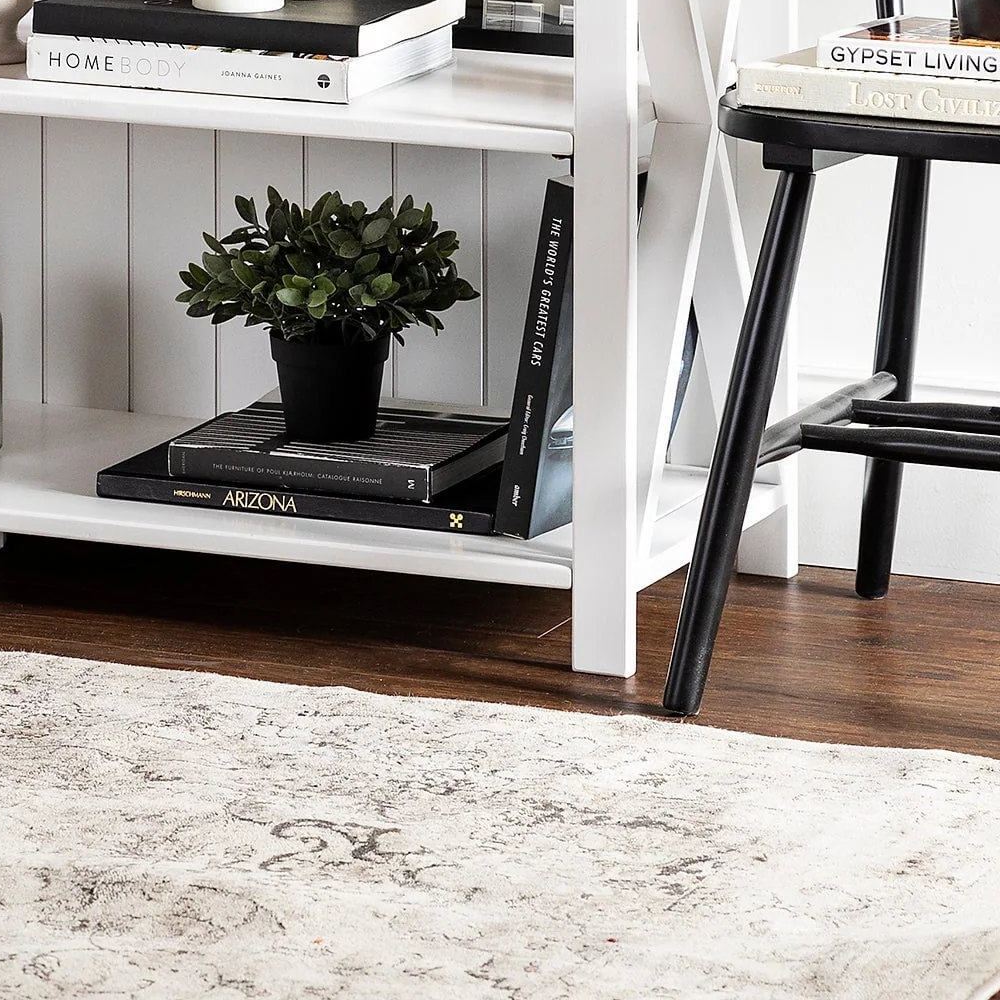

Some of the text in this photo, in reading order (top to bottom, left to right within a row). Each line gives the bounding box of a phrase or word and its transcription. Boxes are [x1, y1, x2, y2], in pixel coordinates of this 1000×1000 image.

[49, 51, 187, 78] HOMEBODY
[831, 46, 998, 74] GYPSET LIVING
[221, 70, 283, 81] JOANNA GAINES
[530, 217, 563, 367] THE WORLD'S GREATEST CARS
[212, 463, 223, 471] THE
[225, 464, 254, 473] FURNITURE
[317, 473, 350, 482] CATALOGUE
[173, 488, 212, 500] HIRSCHMANN
[222, 490, 298, 513] ARIZONA
